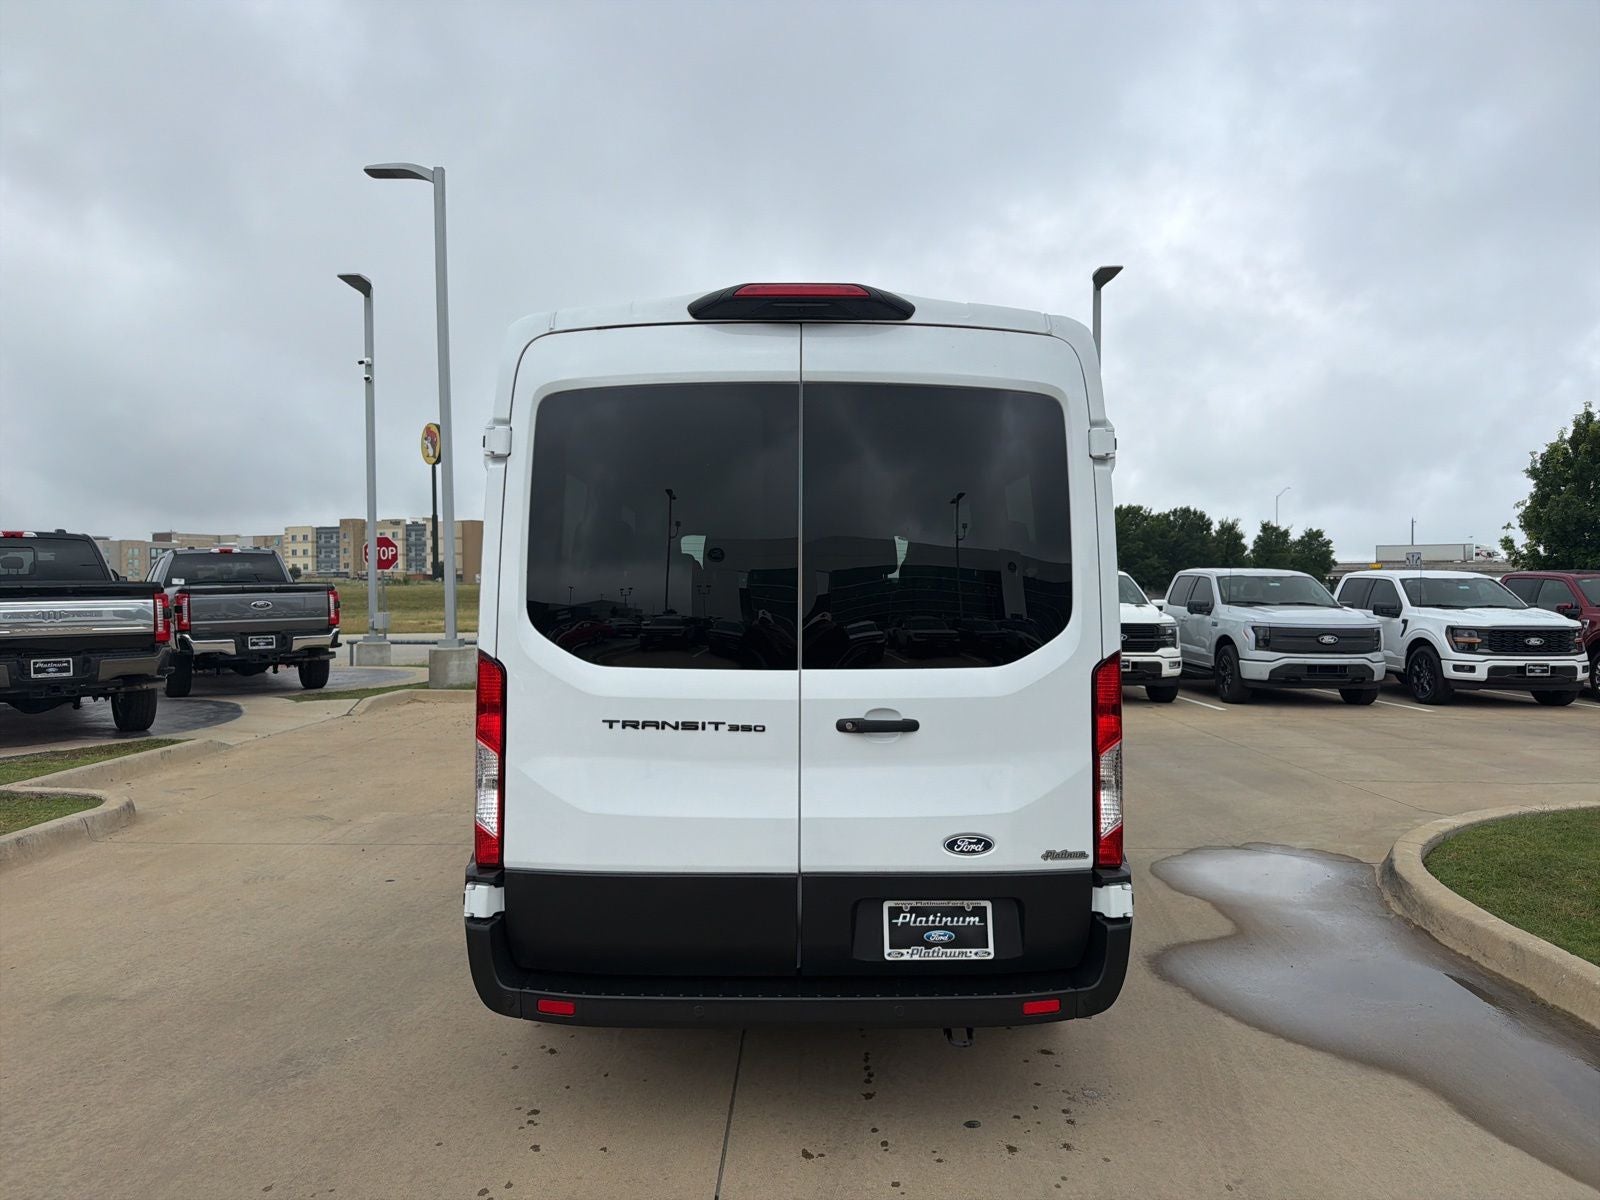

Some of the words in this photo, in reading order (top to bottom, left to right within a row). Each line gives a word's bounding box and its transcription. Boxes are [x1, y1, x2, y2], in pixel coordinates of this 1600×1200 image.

[602, 719, 726, 731] TRANSIT
[727, 724, 766, 732] 350
[1041, 849, 1089, 861] Platinum
[892, 913, 984, 927] Platinum
[909, 947, 973, 959] Platinum
